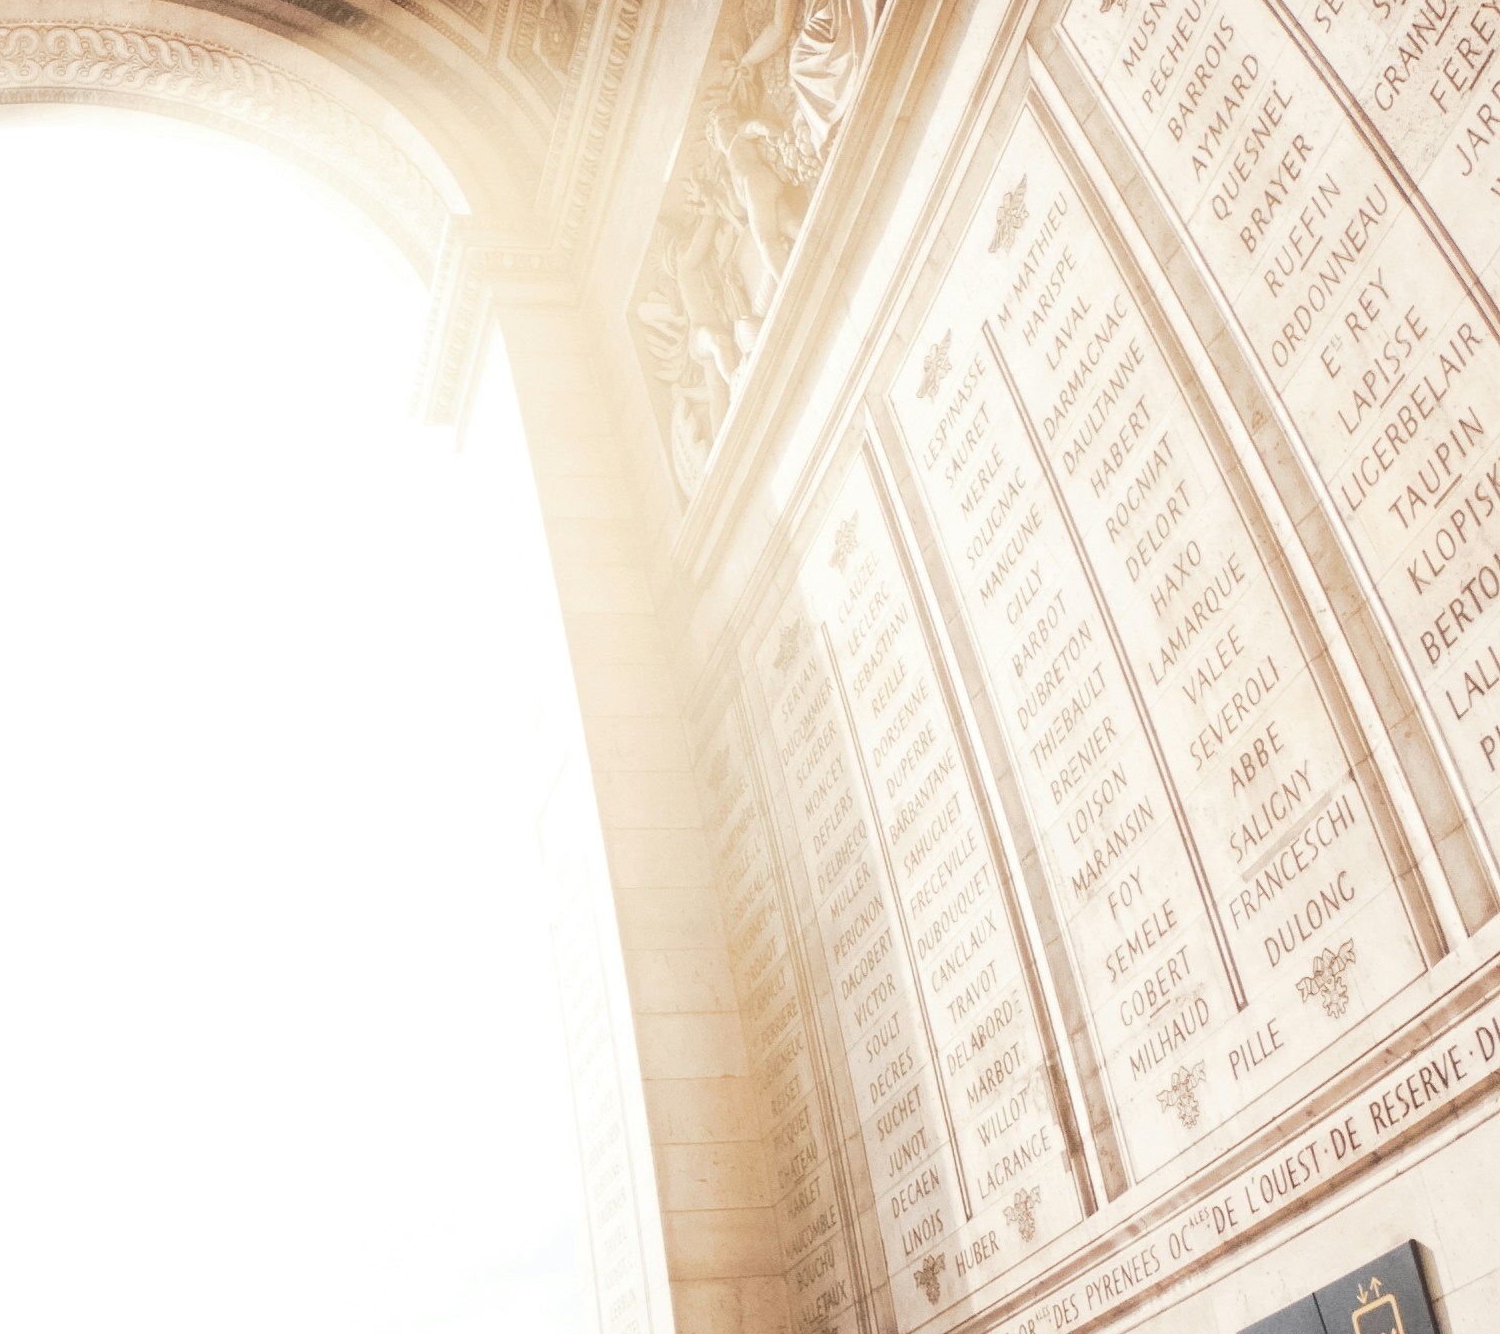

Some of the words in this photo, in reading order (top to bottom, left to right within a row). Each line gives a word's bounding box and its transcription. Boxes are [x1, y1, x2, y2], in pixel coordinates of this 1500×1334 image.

[1168, 15, 1235, 143] BARROIS
[1191, 54, 1259, 182] AYMARD
[1211, 88, 1294, 221] QUESNEL
[1239, 134, 1314, 254] BRAYER
[1011, 191, 1070, 302] MATHIEU
[1263, 173, 1342, 298] RUFFIN
[1271, 183, 1389, 368] ORDONNEAU
[1021, 245, 1078, 347] HARISPE
[1045, 295, 1092, 371] LAVAL
[1344, 266, 1390, 343] REY
[1061, 337, 1146, 476] DAULTANNE
[1337, 305, 1429, 435] LAPISSE
[1090, 395, 1151, 499] HABERT
[1388, 406, 1484, 529] TAUPIN
[1125, 478, 1193, 583] DELORT
[1150, 540, 1202, 616] HAXO
[1011, 589, 1068, 679] BARBOT
[1148, 552, 1246, 686] LAMARQUE
[1181, 624, 1246, 705] VALEE
[1016, 620, 1094, 731] DUBRETON
[1189, 655, 1281, 772] SEVEROLI
[1050, 716, 1119, 806] BRENIER
[1066, 763, 1129, 844] LOISON
[1228, 720, 1285, 798] ABBE
[1071, 795, 1156, 899] MARANSIN
[1107, 865, 1143, 920] FOY
[1229, 794, 1356, 930] FRANCESCHI
[1106, 898, 1178, 983] SEMELE
[965, 1042, 1022, 1109] MARBOT
[1129, 997, 1210, 1081] MILHAUD
[1228, 1018, 1284, 1080] PILLE
[876, 1083, 923, 1142] SUCHET
[888, 1127, 929, 1178] JUNOT
[891, 1164, 940, 1218] DECAEN
[1084, 1243, 1162, 1311] PYRENEES
[1211, 1196, 1238, 1235] DE
[1244, 1141, 1321, 1214] L'OUEST
[1329, 1116, 1362, 1161] DE
[1368, 1044, 1467, 1135] RESERVE
[902, 1209, 945, 1257] LINOIS
[954, 1230, 1000, 1278] HUBER
